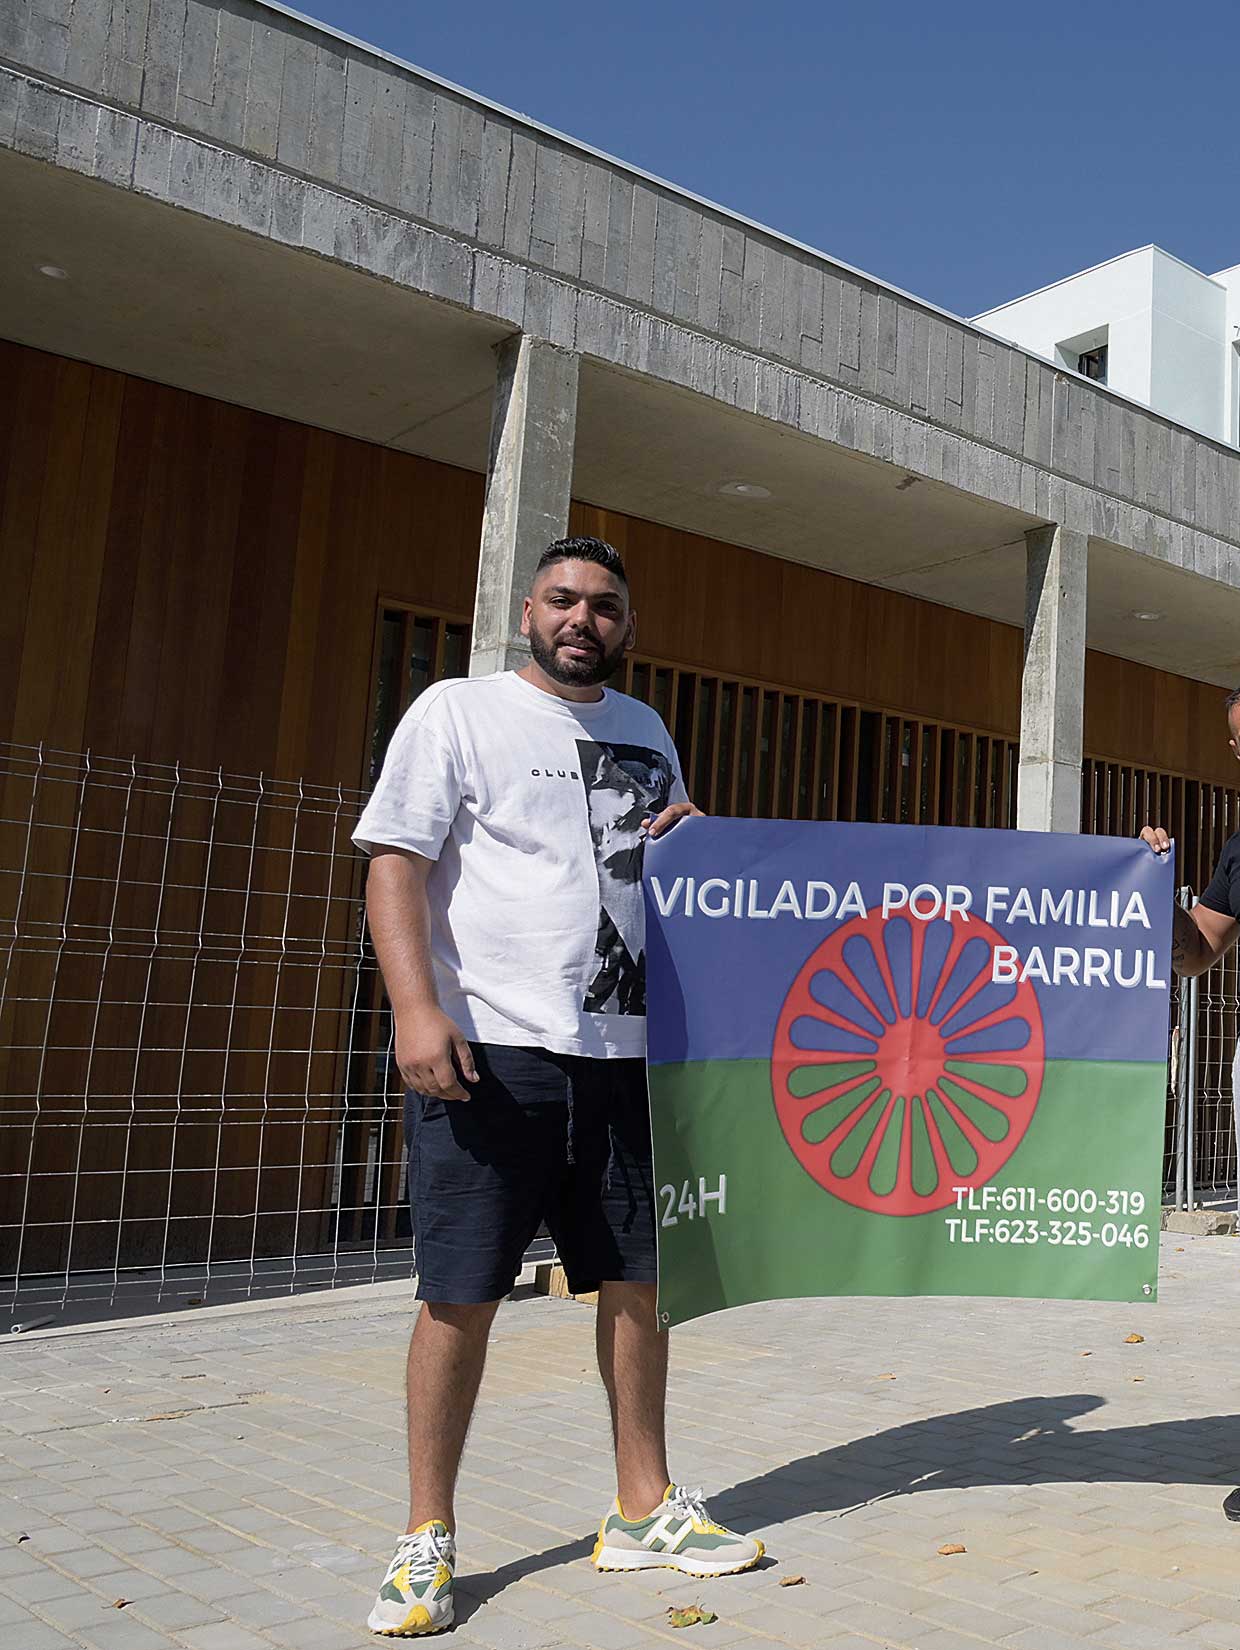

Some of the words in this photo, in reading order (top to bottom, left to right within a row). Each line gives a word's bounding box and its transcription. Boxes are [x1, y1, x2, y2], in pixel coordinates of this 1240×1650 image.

[531, 768, 580, 780] CLUB
[650, 876, 869, 920] VIGILADA
[881, 882, 973, 922] POR
[985, 886, 1152, 929] FAMILIA
[991, 945, 1167, 989] BARRUL
[659, 1174, 727, 1228] 24H
[952, 1186, 1145, 1216] TLF:611-600-319
[945, 1218, 1150, 1249] TLF:623-325-046
